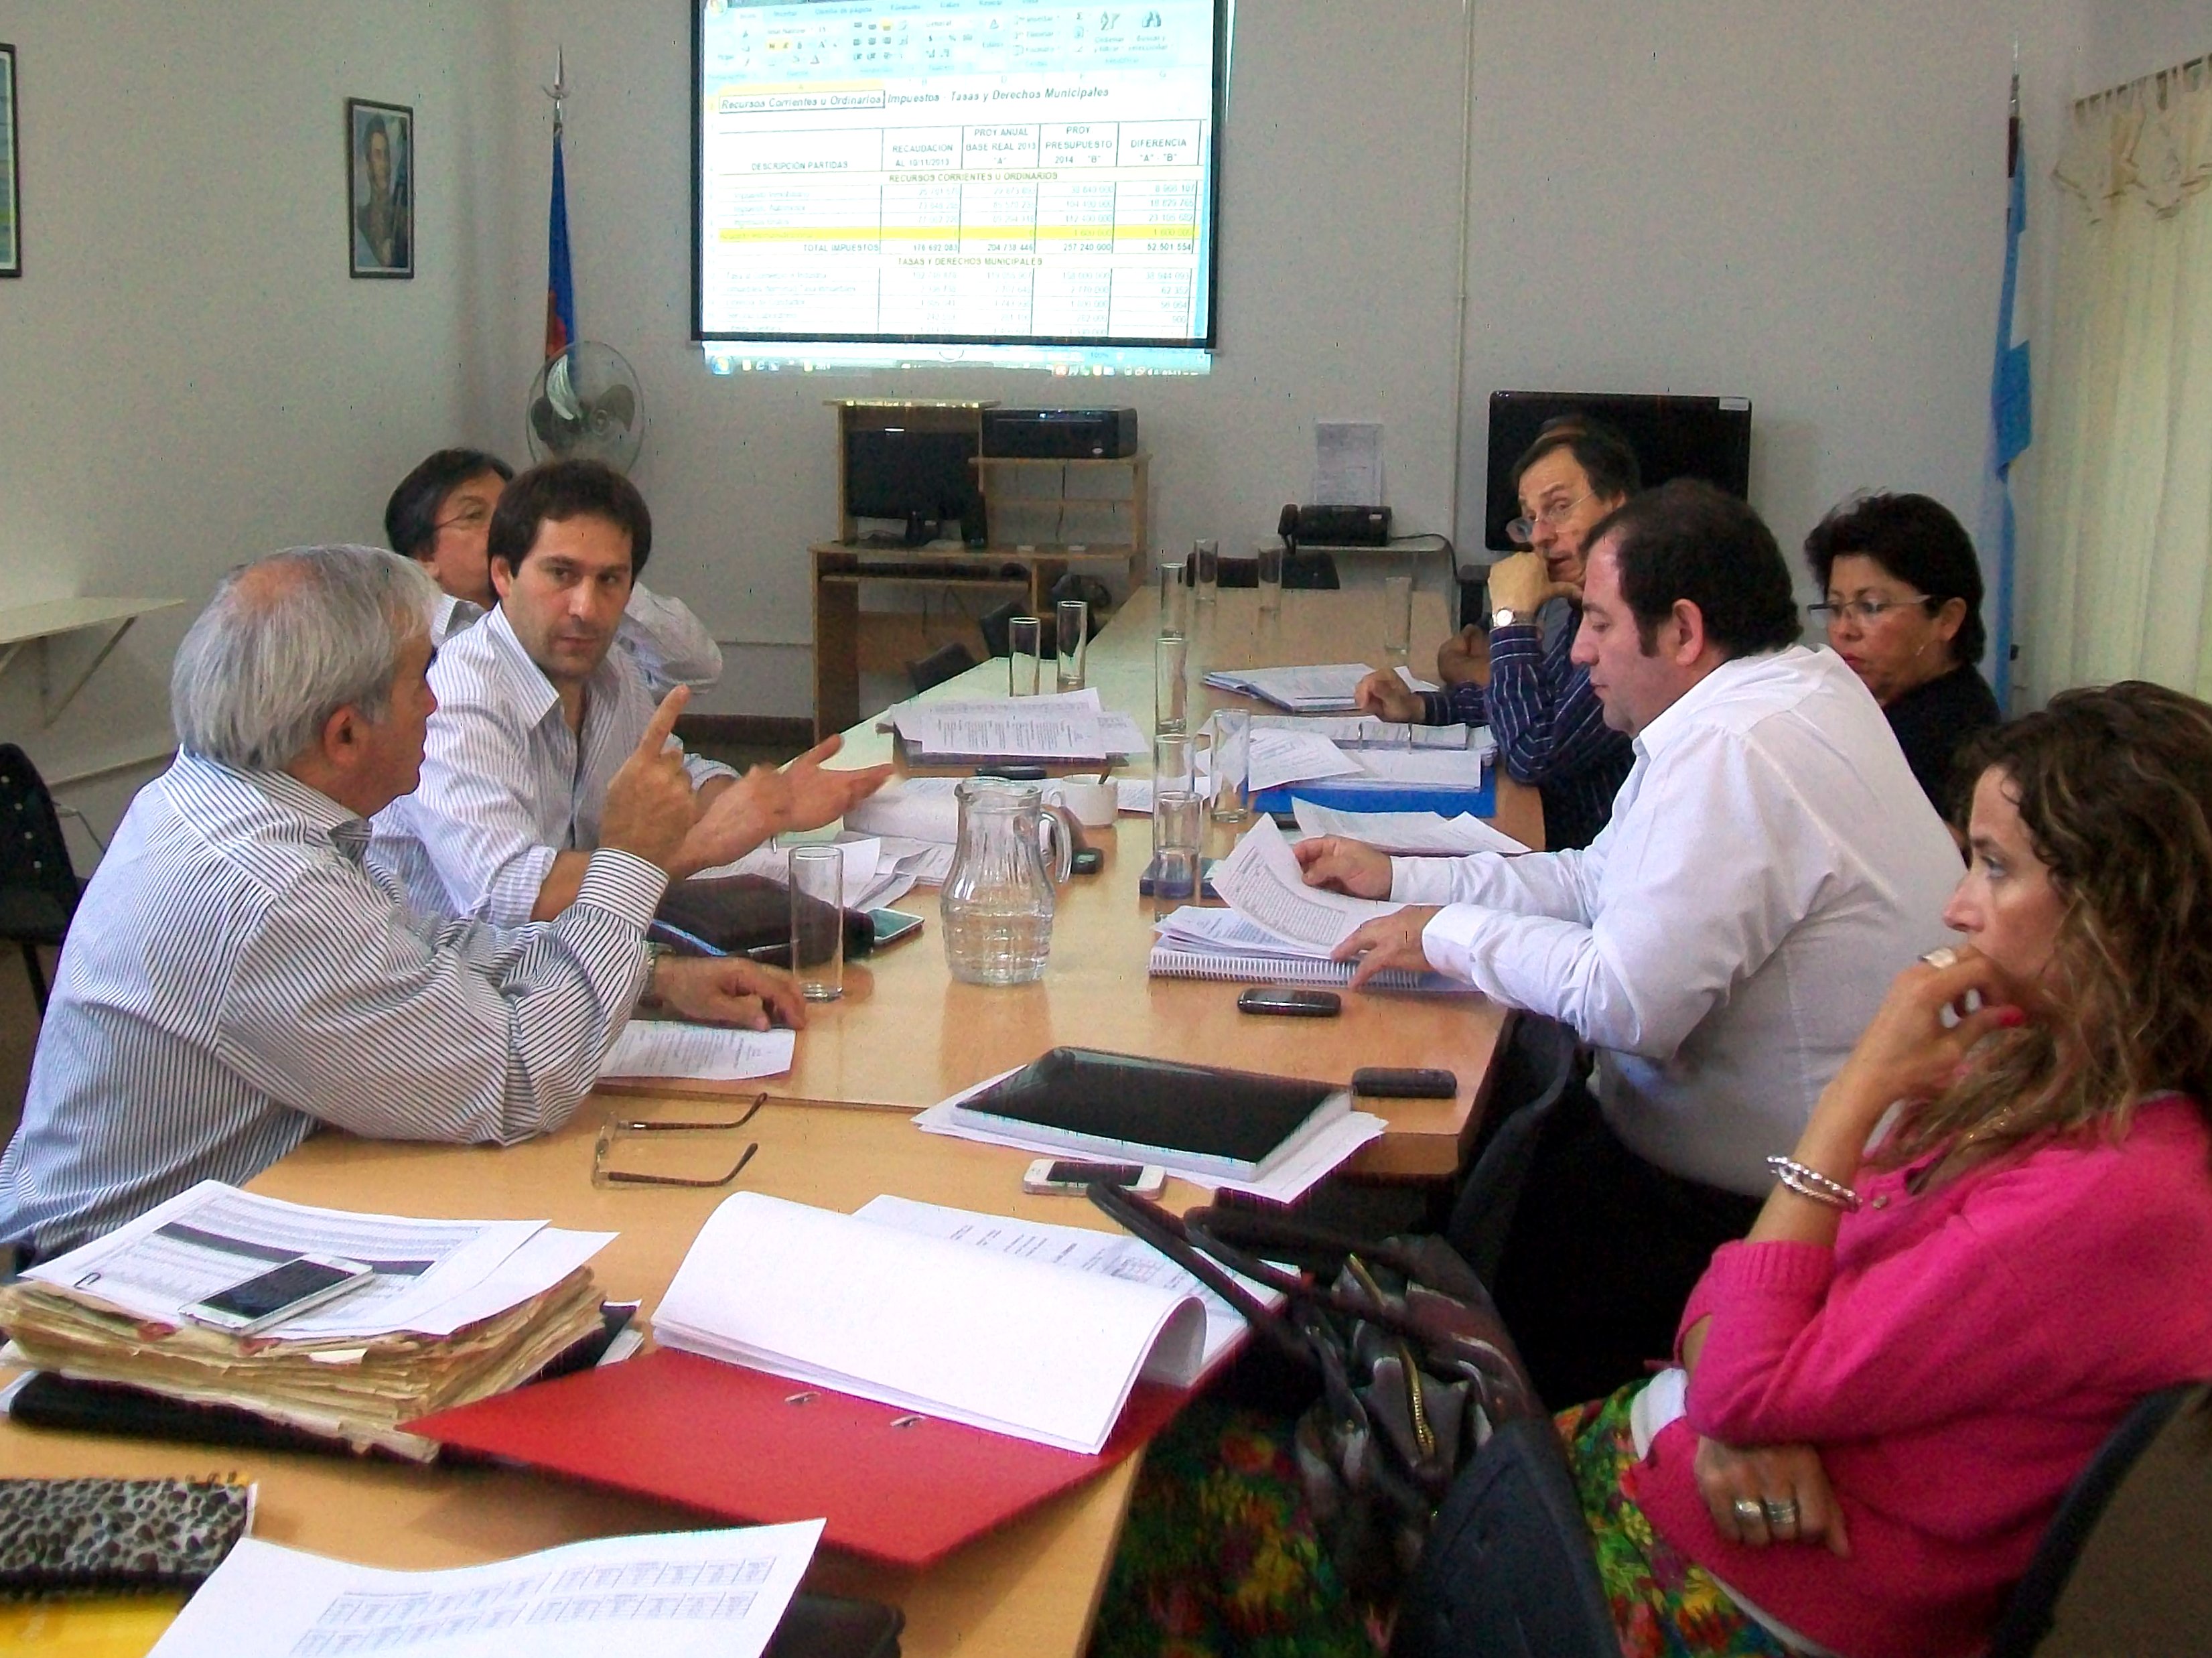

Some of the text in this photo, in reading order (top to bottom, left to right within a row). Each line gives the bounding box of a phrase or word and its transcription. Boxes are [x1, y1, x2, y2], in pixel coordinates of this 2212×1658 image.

[888, 94, 940, 105] Impuestos
[951, 90, 979, 101] Tasas
[983, 93, 989, 102] y
[992, 89, 1041, 100] Derechos
[1044, 87, 1109, 100] Municipales
[721, 94, 882, 110] Recursos Corrientes u Ordinarios
[1000, 128, 1029, 136] ANUAL
[1045, 140, 1113, 149] PRESUPUESTO
[1130, 139, 1187, 148] DIFERENCIA
[1054, 155, 1074, 163] 2014
[807, 160, 849, 169] PARTIDAS
[889, 174, 935, 182] RECURSOS
[937, 173, 993, 182] CORRIENTES
[1004, 171, 1058, 181] ORDINARIOS
[803, 243, 880, 253] TOTAL IMPUESTOS
[898, 258, 925, 266] TASAS
[935, 258, 982, 266] DERECHOS
[985, 257, 1043, 266] MUNICIPALES
